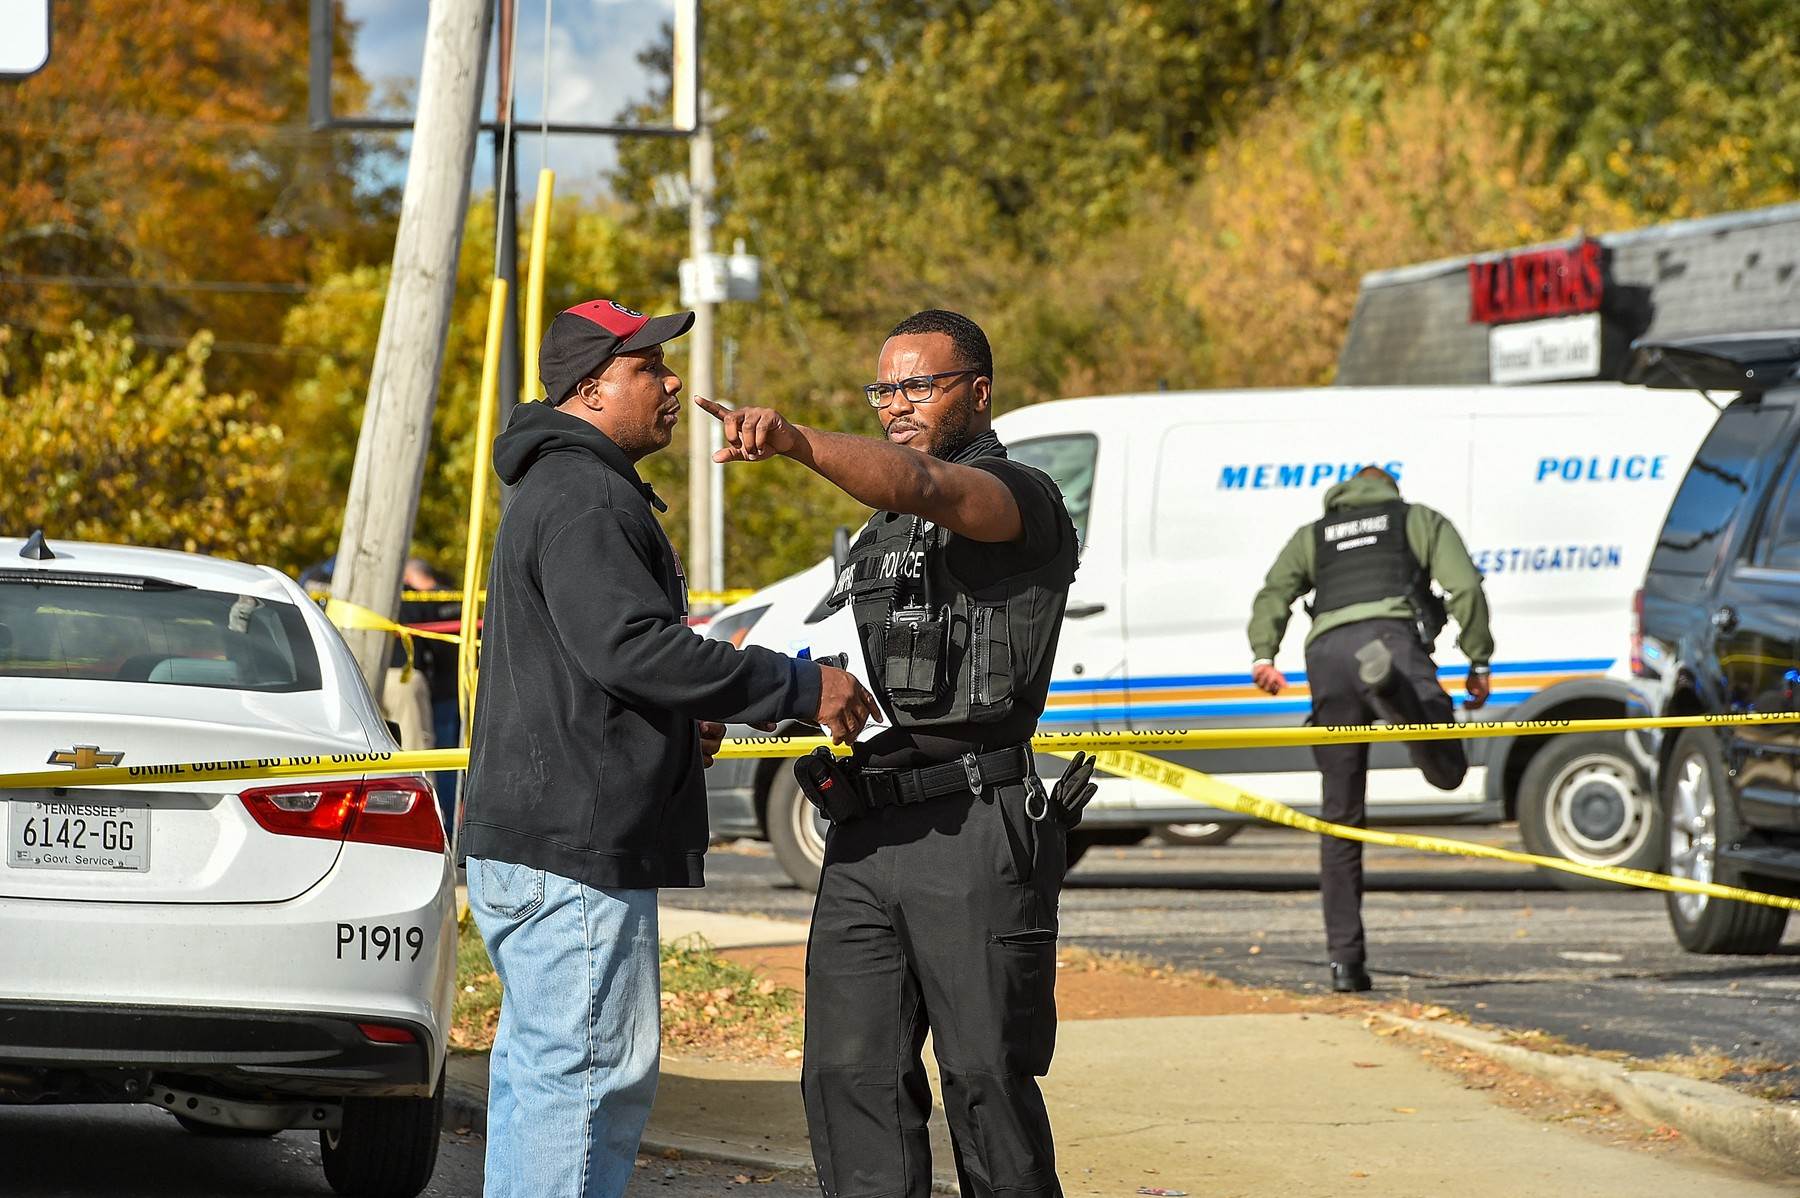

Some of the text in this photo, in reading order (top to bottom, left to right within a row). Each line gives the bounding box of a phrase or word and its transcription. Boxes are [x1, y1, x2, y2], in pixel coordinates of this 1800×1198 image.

[1216, 455, 1669, 490] MEMPHS POLICE
[1473, 545, 1623, 574] ESTIGATION
[43, 803, 117, 817] TENNESSEE
[23, 817, 133, 851] 6142-GG
[43, 853, 114, 866] Govt. Service
[336, 923, 424, 962] P1919
